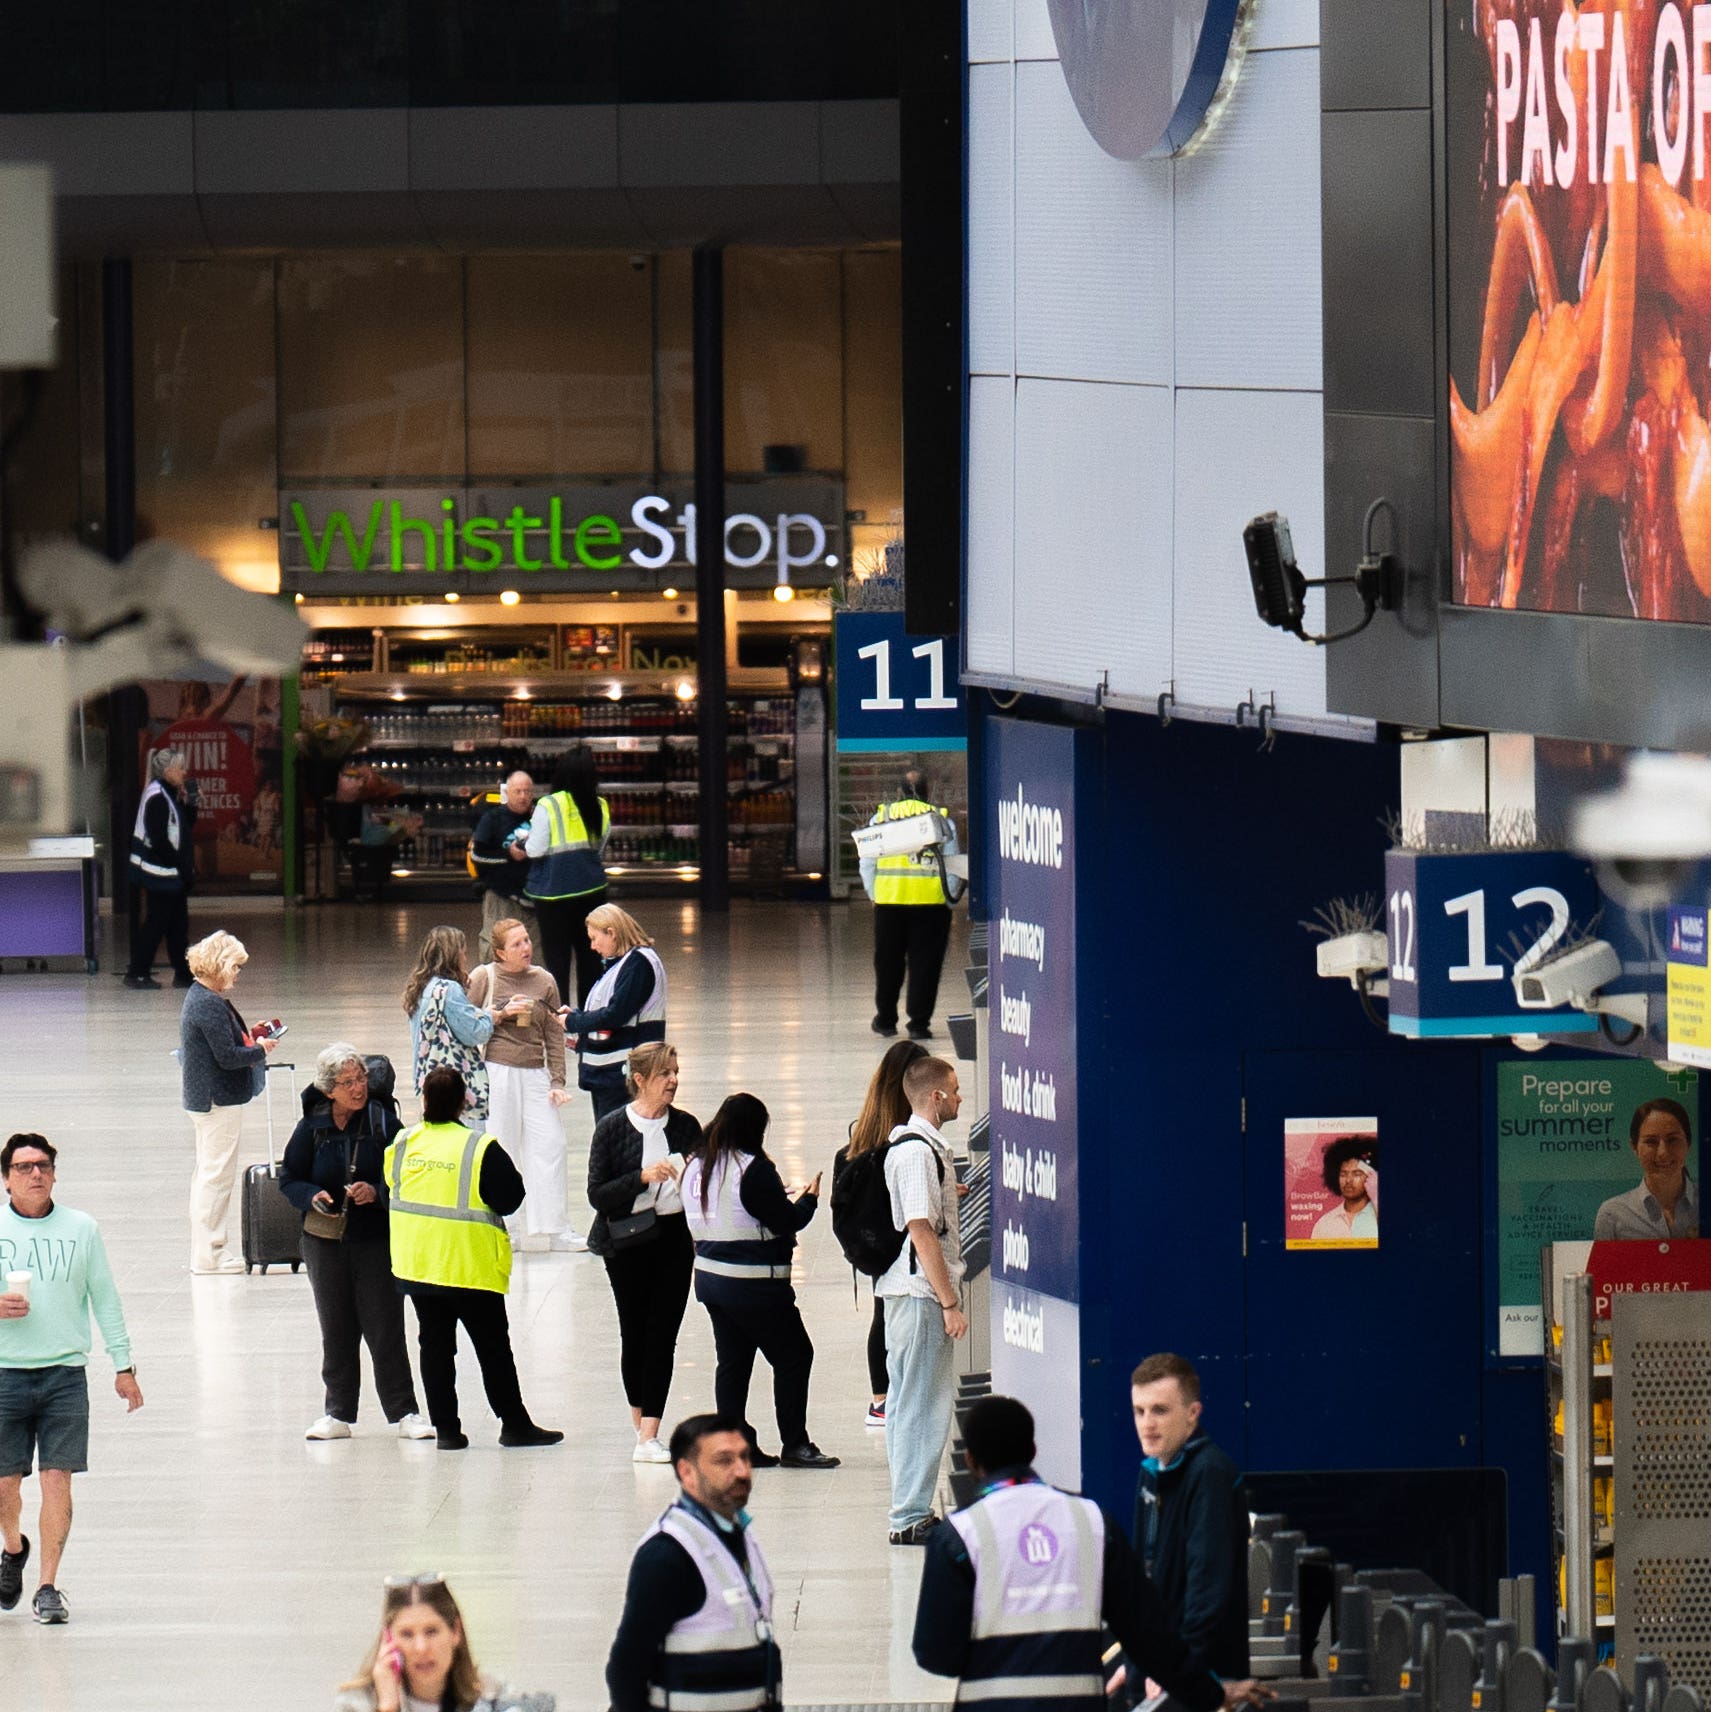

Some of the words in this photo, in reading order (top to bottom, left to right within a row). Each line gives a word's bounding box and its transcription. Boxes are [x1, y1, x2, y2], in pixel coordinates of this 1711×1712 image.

[1497, 6, 1635, 188] PASTA
[857, 638, 959, 711] 11
[998, 783, 1063, 870] welcome
[999, 909, 1045, 973] pharmacy
[1390, 888, 1417, 982] 12
[1443, 886, 1571, 981] 12
[1000, 992, 1031, 1048] beauty
[1001, 1060, 1022, 1114] food
[1024, 1071, 1036, 1114] &
[1035, 1071, 1057, 1122] drink
[1522, 1074, 1612, 1102] Prepare
[1538, 1099, 1560, 1114] for
[1561, 1099, 1580, 1113] all
[1582, 1102, 1615, 1117] your
[1500, 1116, 1615, 1136] summer
[1539, 1139, 1621, 1152] moments
[427, 1160, 457, 1173] group
[1001, 1146, 1023, 1200] baby
[1024, 1156, 1036, 1194] &
[1036, 1154, 1057, 1202] child
[1290, 1191, 1329, 1201] BrowBar
[1290, 1202, 1324, 1213] waxing
[1290, 1211, 1314, 1222] now!
[1002, 1220, 1030, 1275] photo
[1602, 1282, 1635, 1294] OUR
[1641, 1281, 1691, 1293] GREAT
[1002, 1298, 1044, 1354] electrical
[1505, 1313, 1522, 1323] Ask
[1524, 1314, 1540, 1323] our
